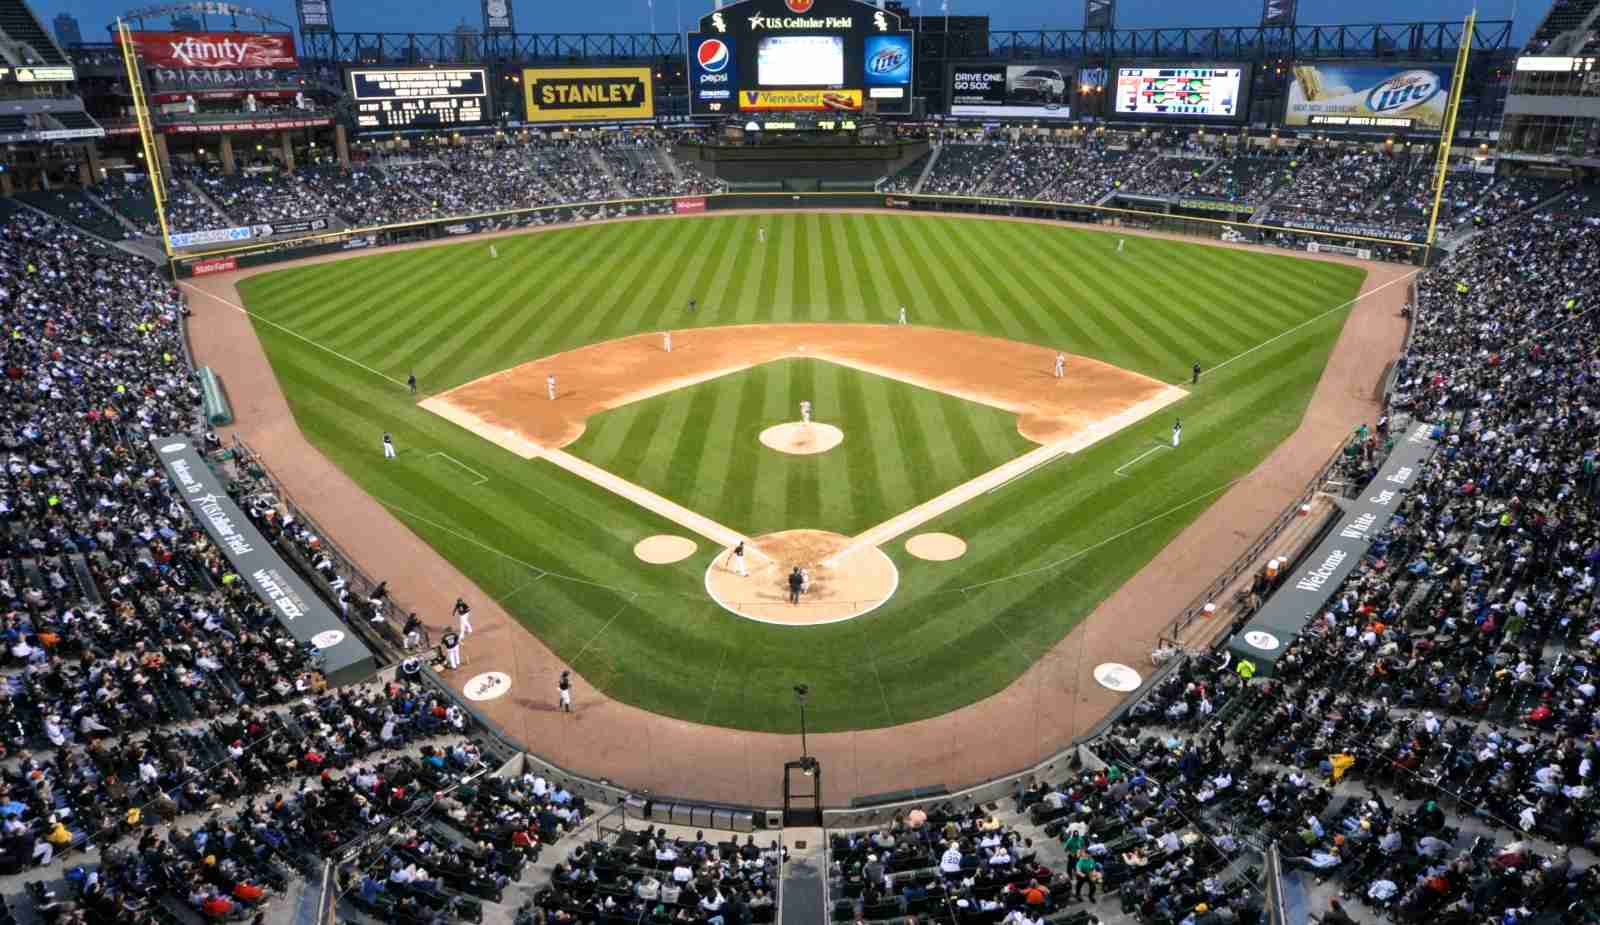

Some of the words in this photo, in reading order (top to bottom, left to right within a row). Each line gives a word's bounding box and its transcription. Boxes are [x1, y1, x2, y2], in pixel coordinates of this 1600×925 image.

[783, 17, 824, 29] Cellular
[825, 17, 852, 29] Field
[170, 36, 249, 65] xfinity
[700, 73, 728, 83] pepsi
[954, 73, 981, 82] DRIVE
[982, 73, 1004, 82] ONE.
[542, 84, 636, 104] STANLEY
[954, 82, 969, 90] GO
[1295, 549, 1348, 592] Welcome
[1340, 512, 1377, 540] White
[252, 568, 285, 600] WHITE
